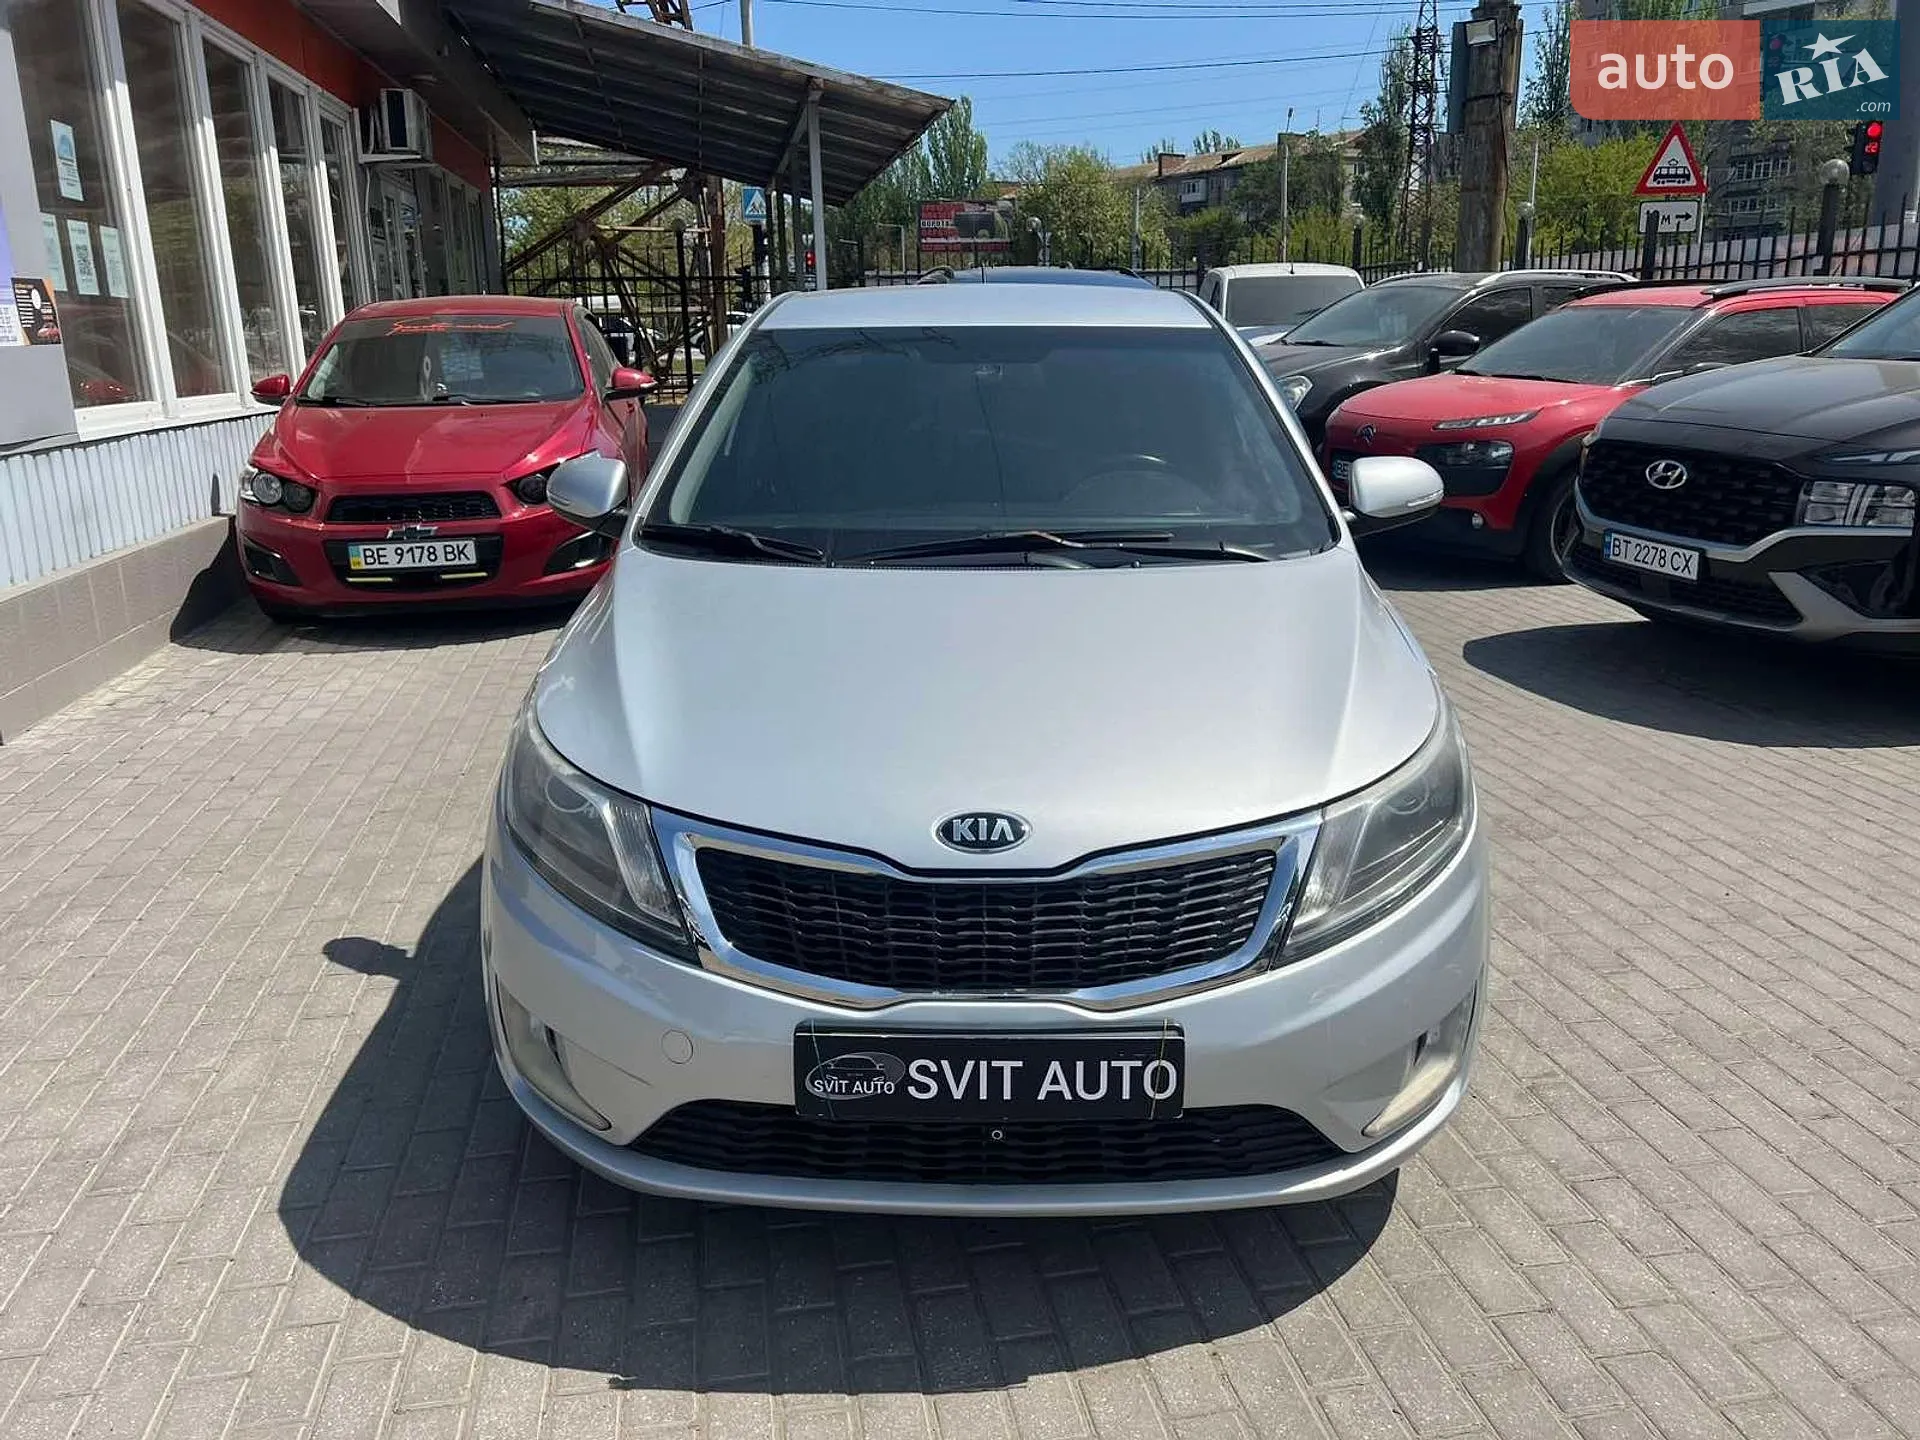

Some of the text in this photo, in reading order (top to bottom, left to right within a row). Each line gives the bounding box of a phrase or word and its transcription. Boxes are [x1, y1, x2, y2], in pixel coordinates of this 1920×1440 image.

[363, 547, 389, 565] BE
[394, 546, 438, 564] 9178
[443, 543, 471, 562] BK
[1612, 538, 1693, 574] BT 2278 CX
[952, 818, 1015, 841] KIA
[813, 1079, 895, 1095] SVIT AUTO
[907, 1058, 1178, 1100] SVIT AUTO
